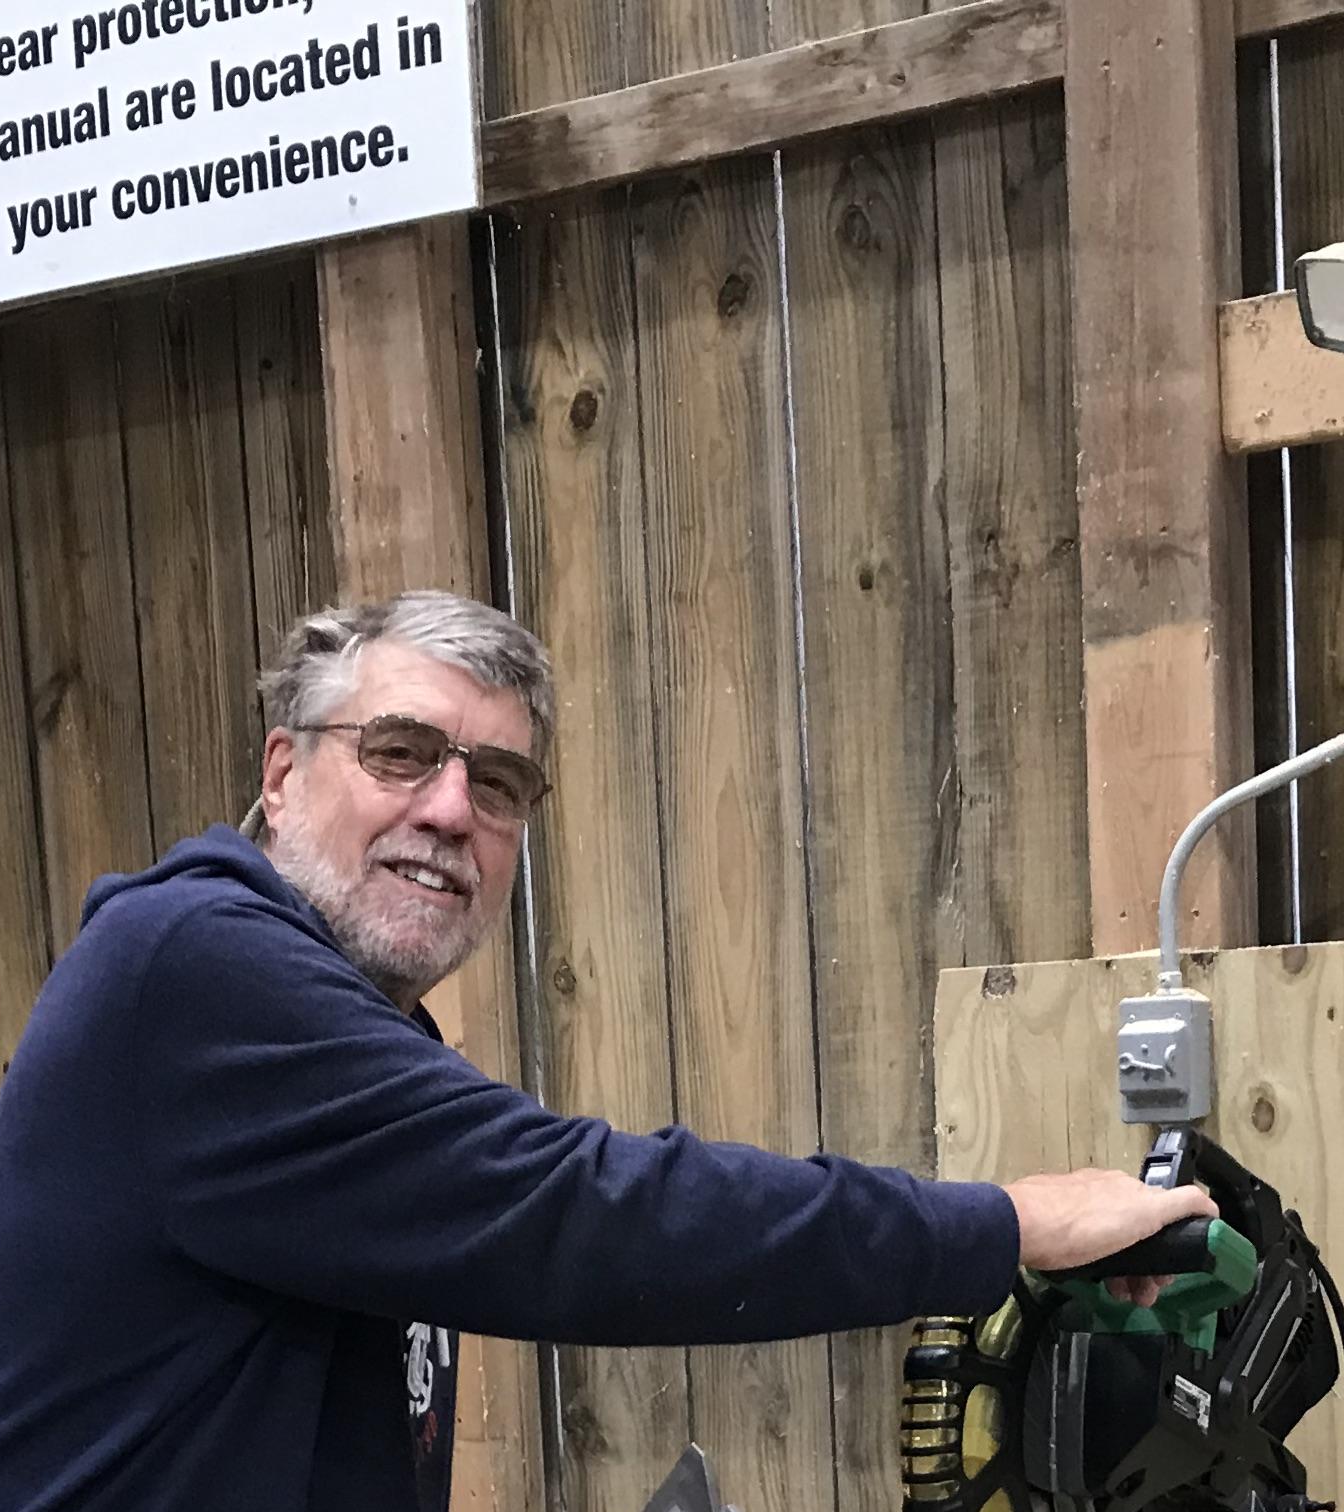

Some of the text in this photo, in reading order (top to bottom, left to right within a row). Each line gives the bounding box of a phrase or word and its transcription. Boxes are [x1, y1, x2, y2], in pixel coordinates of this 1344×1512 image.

[125, 78, 196, 131] are
[210, 23, 381, 112] located
[397, 15, 443, 71] in
[7, 186, 97, 255] your
[112, 124, 409, 221] convenience.
